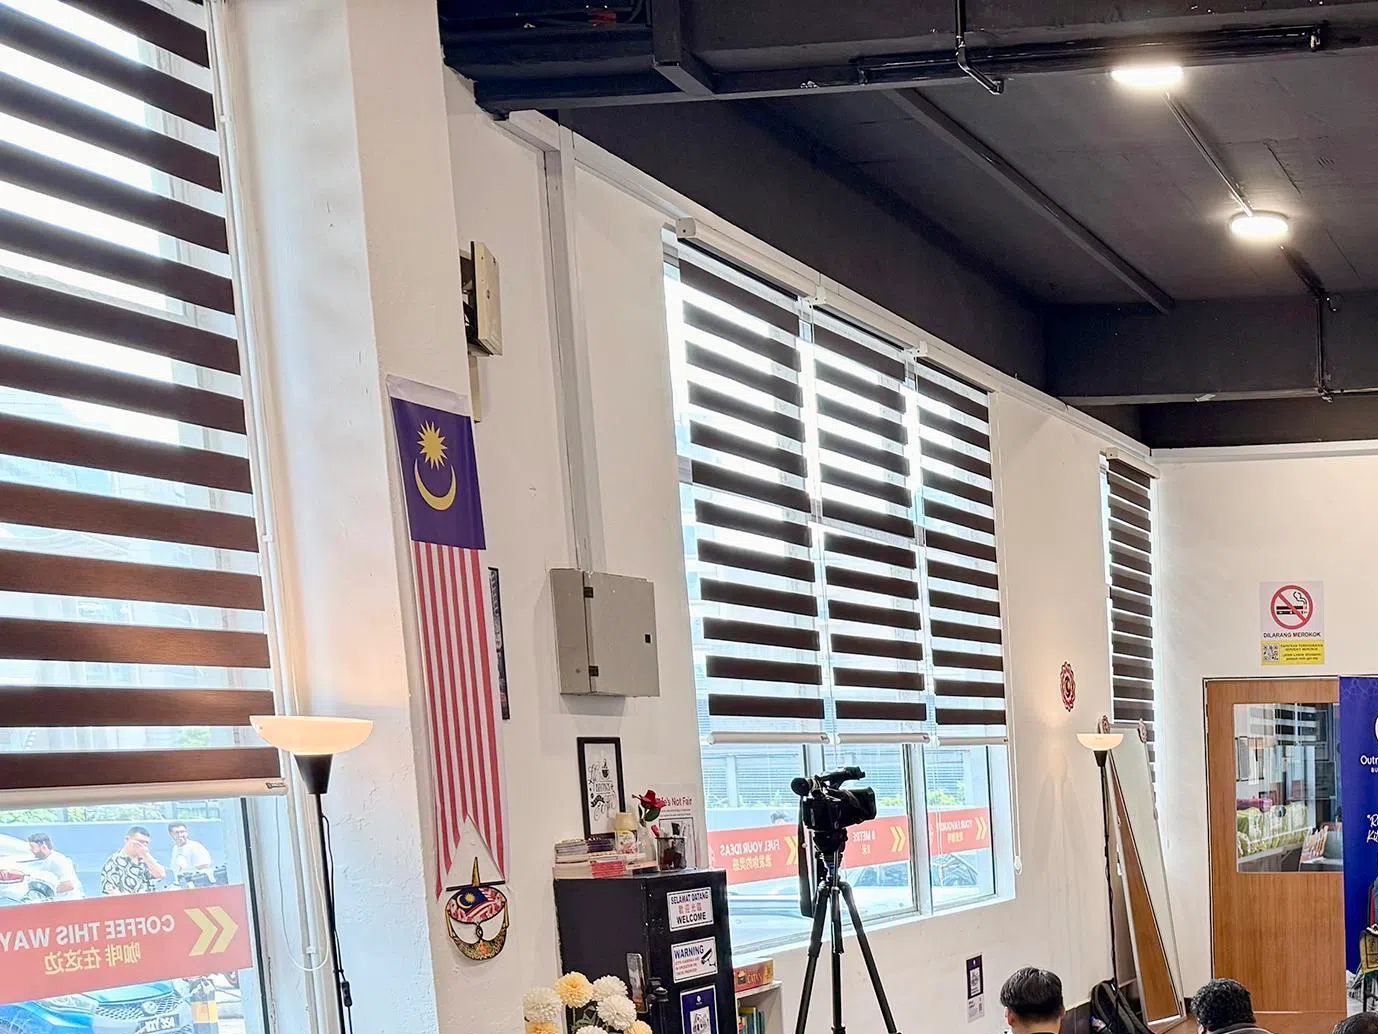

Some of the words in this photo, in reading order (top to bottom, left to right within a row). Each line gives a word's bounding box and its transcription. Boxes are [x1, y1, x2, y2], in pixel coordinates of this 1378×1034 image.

[671, 894, 692, 905] SELAMAT
[691, 892, 709, 902] DATANG
[676, 912, 707, 925] WELCOME
[673, 945, 704, 959] WARNING
